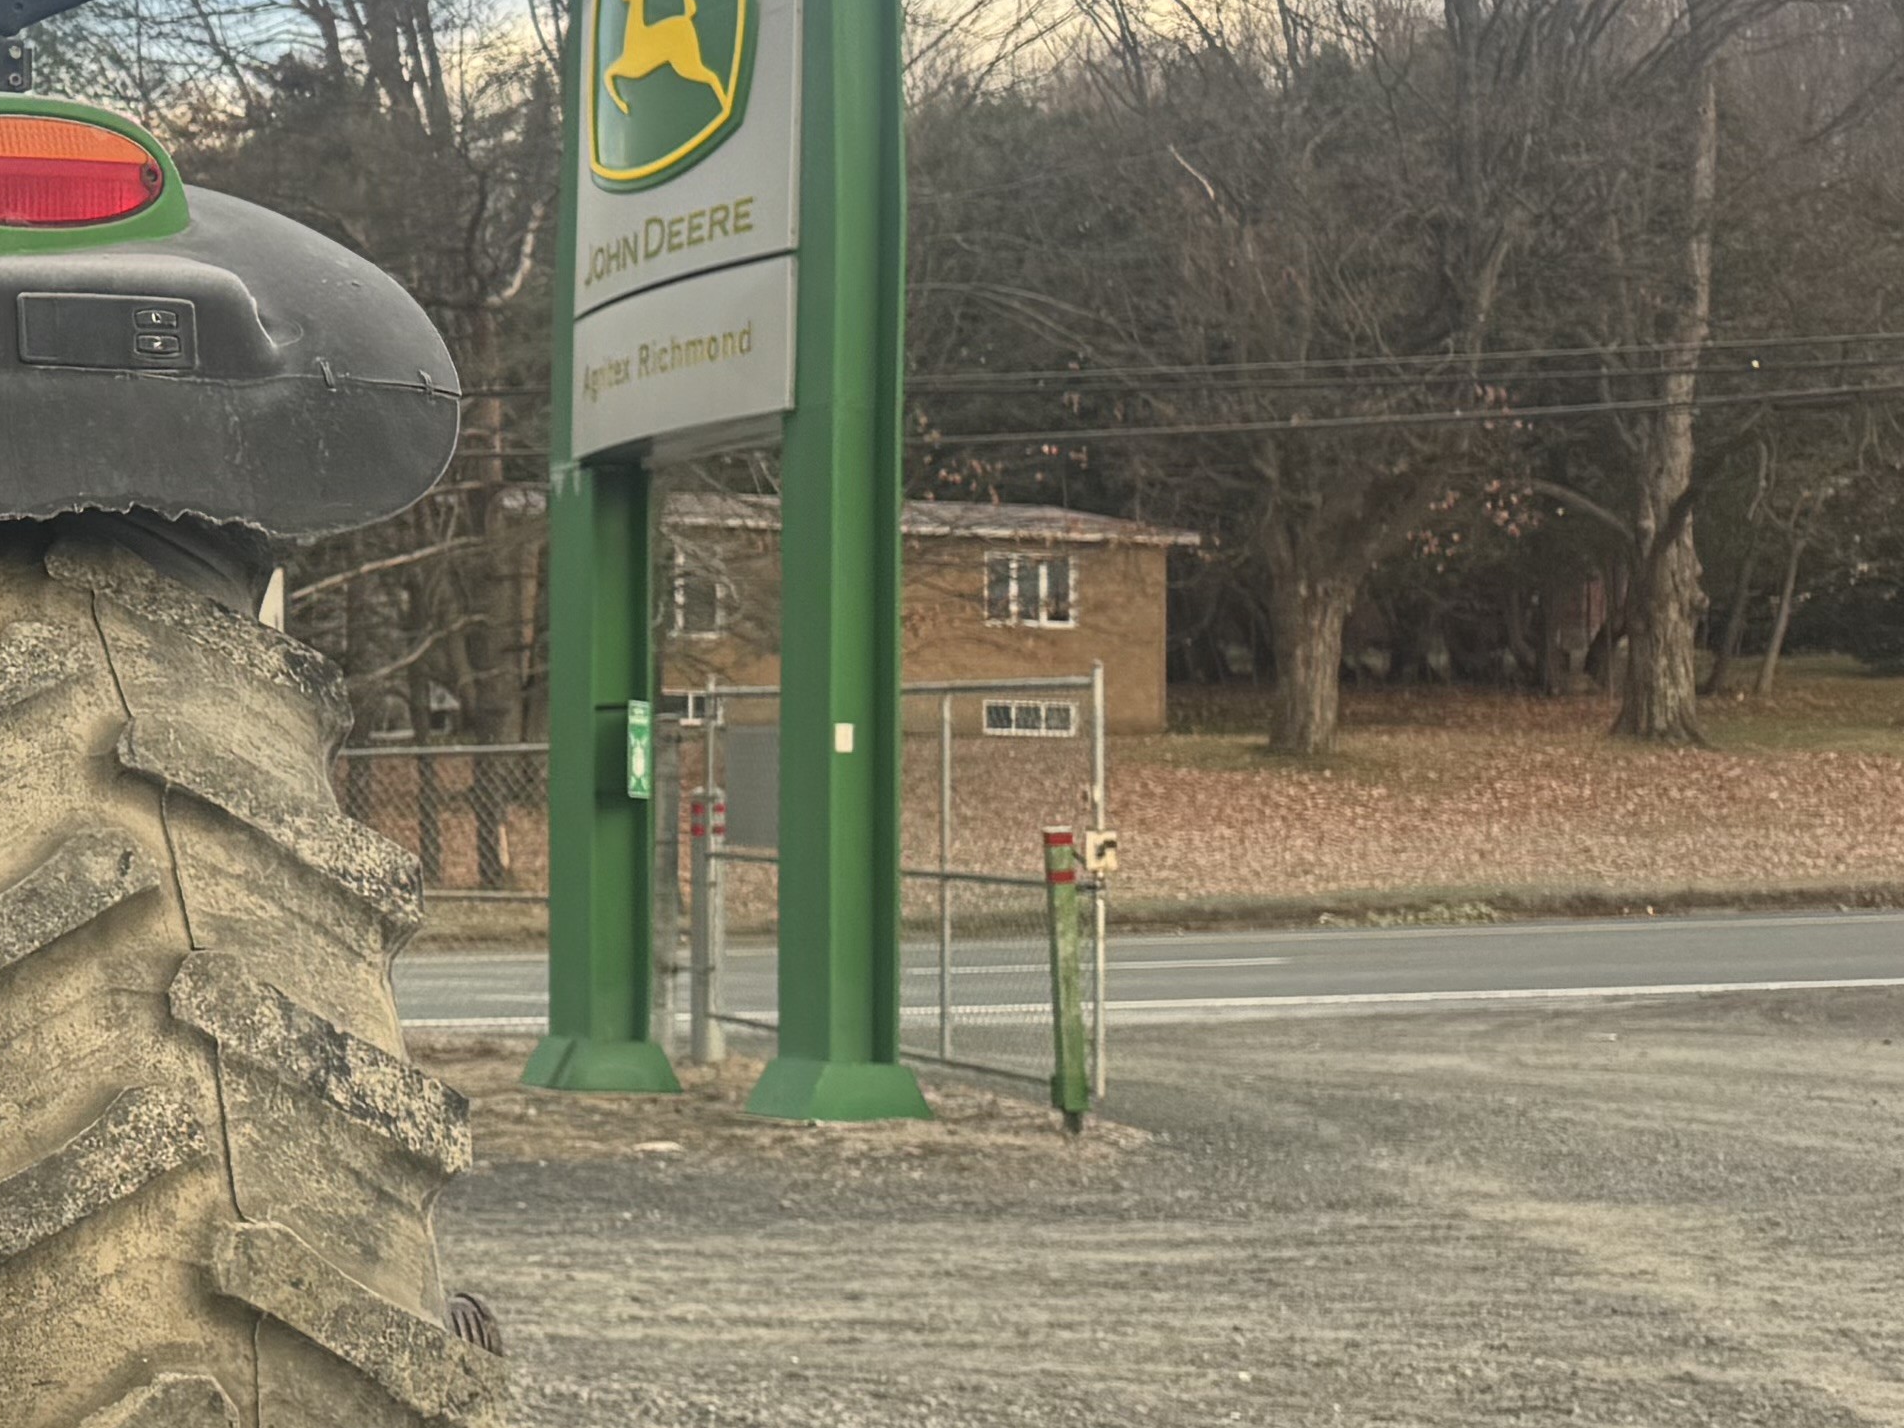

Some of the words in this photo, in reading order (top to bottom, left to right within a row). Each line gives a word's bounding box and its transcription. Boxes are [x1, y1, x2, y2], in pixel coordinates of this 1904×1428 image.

[585, 231, 639, 286] JOHN
[644, 196, 754, 260] DEERE
[638, 321, 753, 380] Richmond
